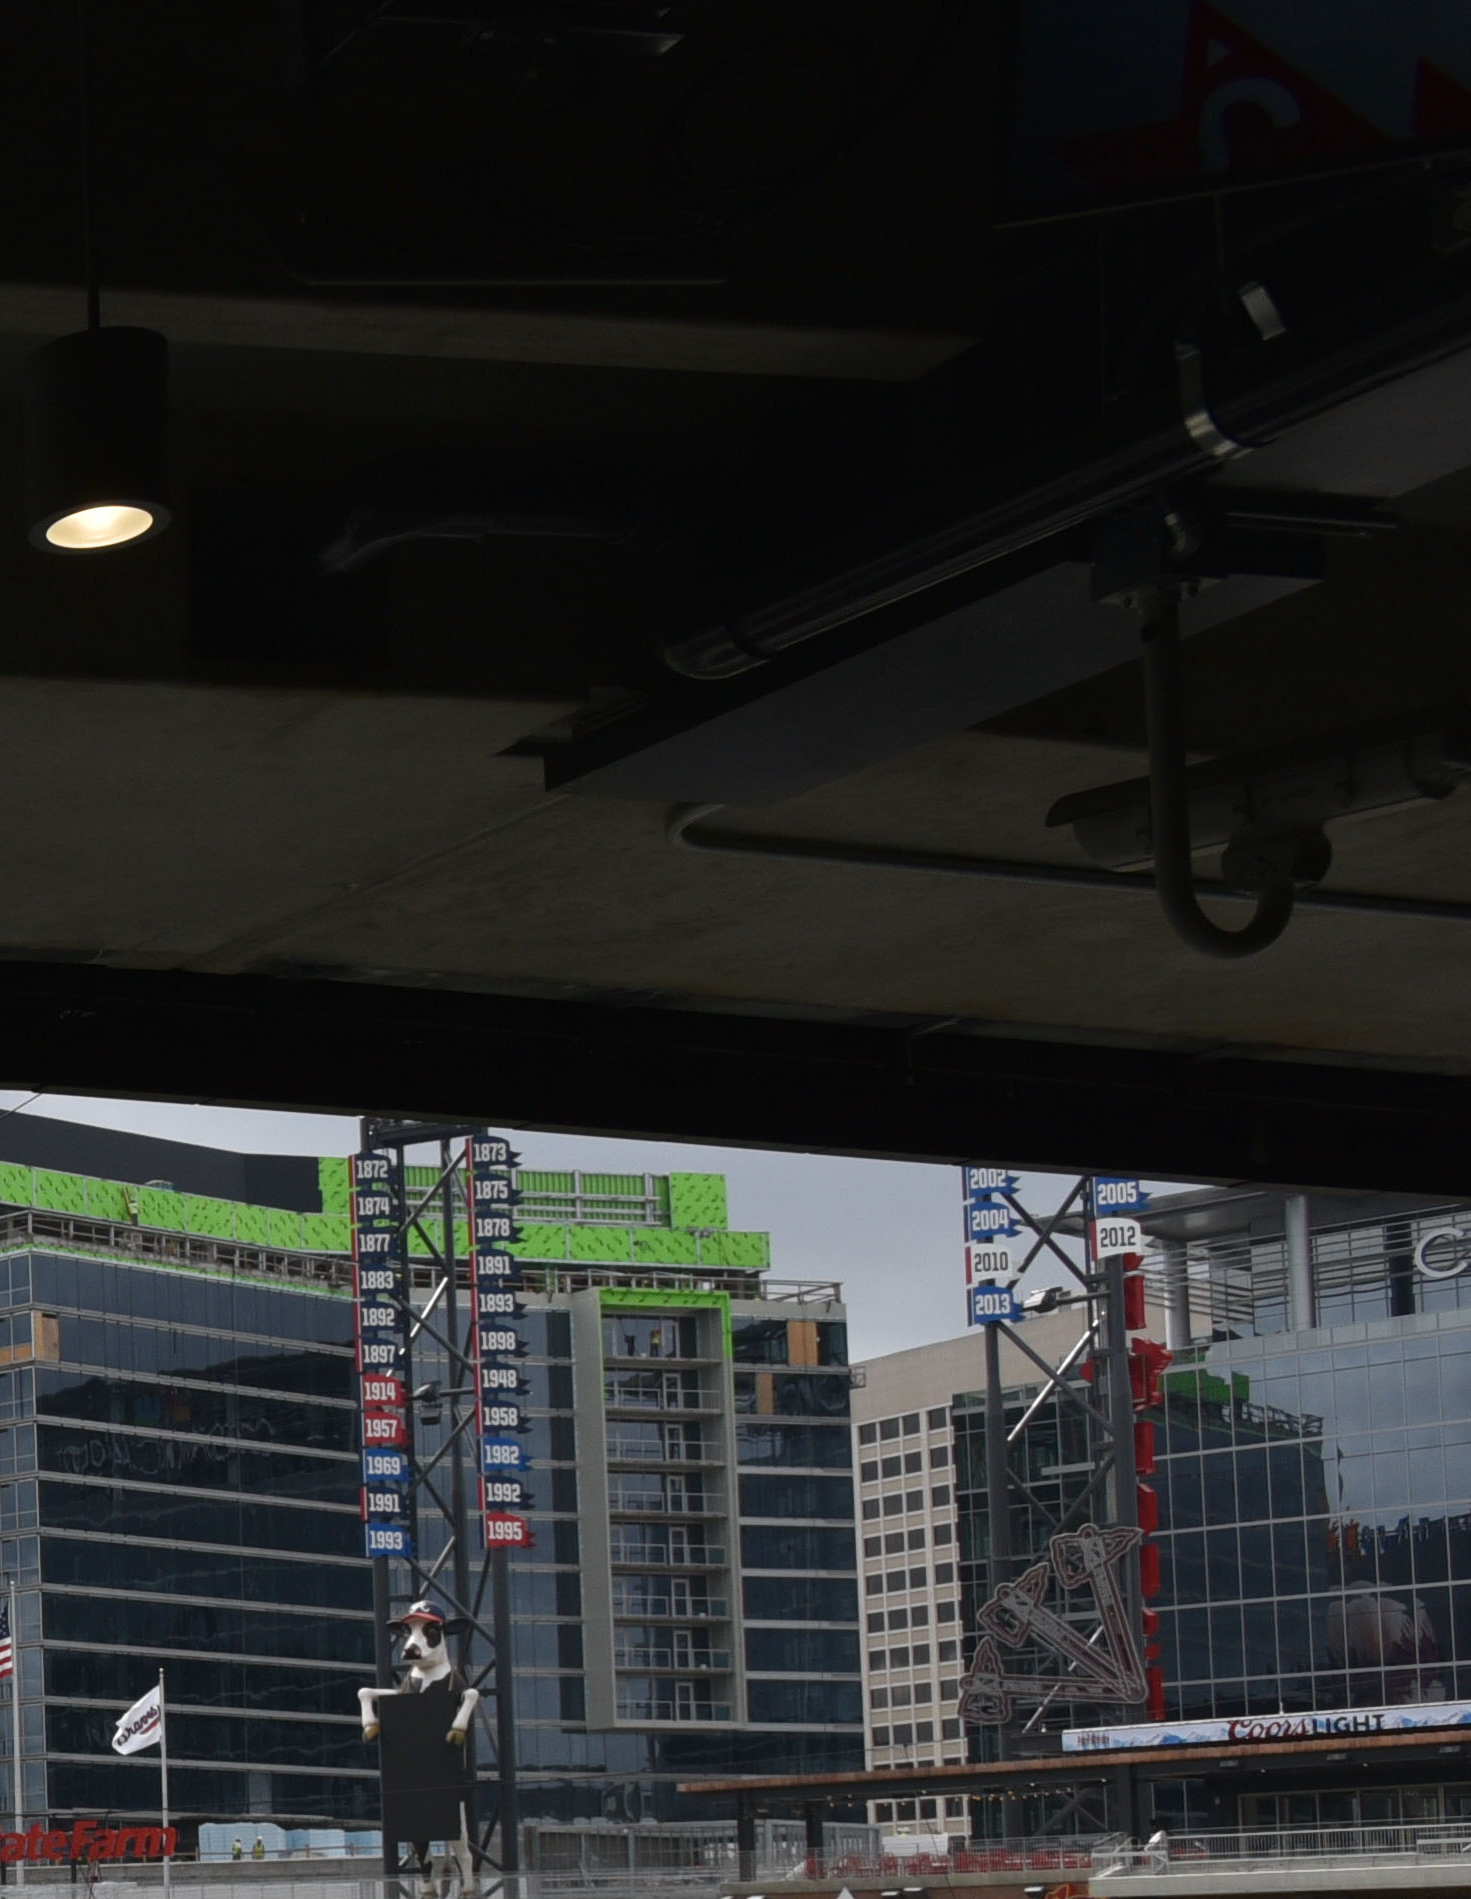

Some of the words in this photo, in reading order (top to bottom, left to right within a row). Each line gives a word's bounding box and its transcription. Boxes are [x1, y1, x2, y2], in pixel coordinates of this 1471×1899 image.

[473, 1143, 507, 1162] 1873
[356, 1159, 388, 1179] 1872
[970, 1169, 1006, 1189] 2002
[475, 1180, 509, 1200] 1875
[1097, 1182, 1136, 1205] 2005
[358, 1196, 390, 1215] 1874
[476, 1218, 511, 1237] 1878
[972, 1208, 1009, 1231] 2004
[359, 1233, 391, 1253] 1877
[1100, 1226, 1136, 1247] 2012
[478, 1255, 512, 1275] 1891
[974, 1251, 1009, 1272] 2010
[360, 1270, 394, 1289] 1883
[479, 1293, 514, 1313] 1893
[975, 1293, 1011, 1315] 2013
[361, 1307, 395, 1326] 1892
[480, 1331, 516, 1351] 1898
[362, 1344, 396, 1364] 1897
[482, 1369, 517, 1389] 1948
[364, 1381, 397, 1401] 1914
[483, 1407, 519, 1427] 1958
[365, 1418, 398, 1438] 1957
[484, 1445, 520, 1465] 1982
[367, 1456, 401, 1475] 1969
[486, 1482, 522, 1502] 1992
[368, 1493, 401, 1512] 1991
[369, 1530, 403, 1549] 1993
[487, 1520, 523, 1541] 1995
[1311, 1713, 1385, 1734] LIGHT
